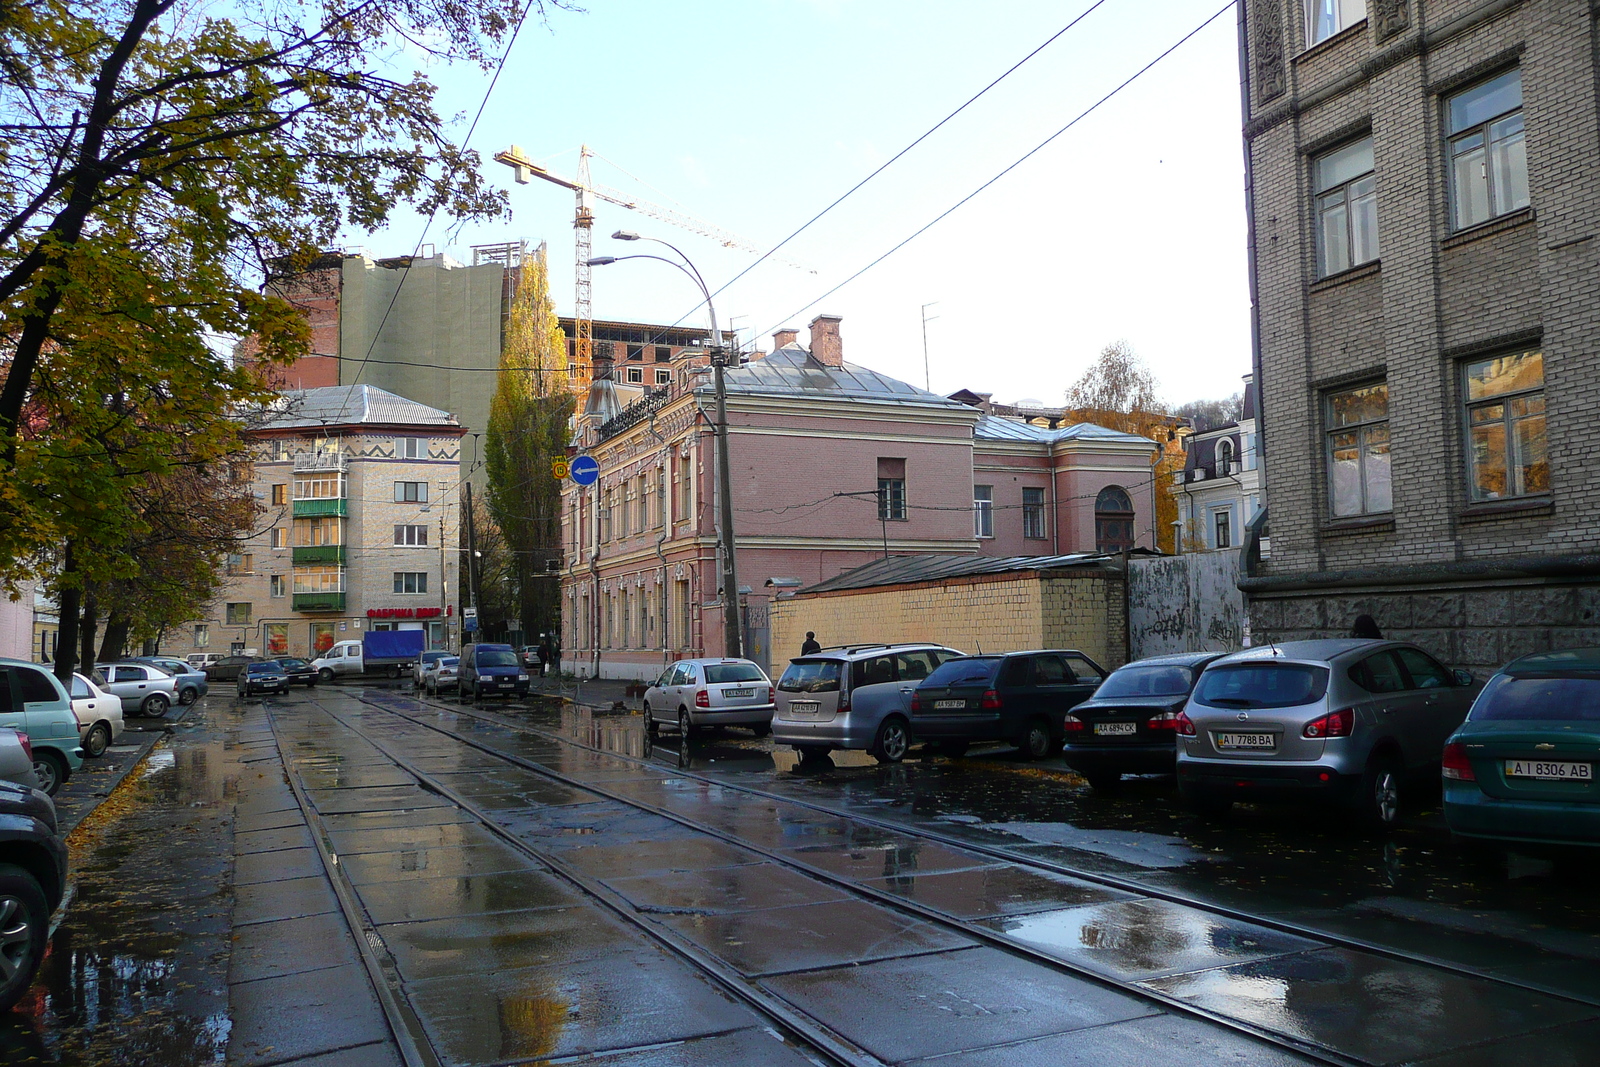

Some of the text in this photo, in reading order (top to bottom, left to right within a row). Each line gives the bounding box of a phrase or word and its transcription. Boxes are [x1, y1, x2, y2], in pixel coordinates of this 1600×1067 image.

[557, 466, 564, 474] 15
[367, 604, 453, 619] ФАБРИКА ДВЕРЙ
[1109, 724, 1124, 732] 6894
[1124, 724, 1134, 732] CK
[1223, 735, 1272, 745] AI 7788 BA
[1536, 763, 1566, 776] 8306
[1570, 764, 1589, 777] AB
